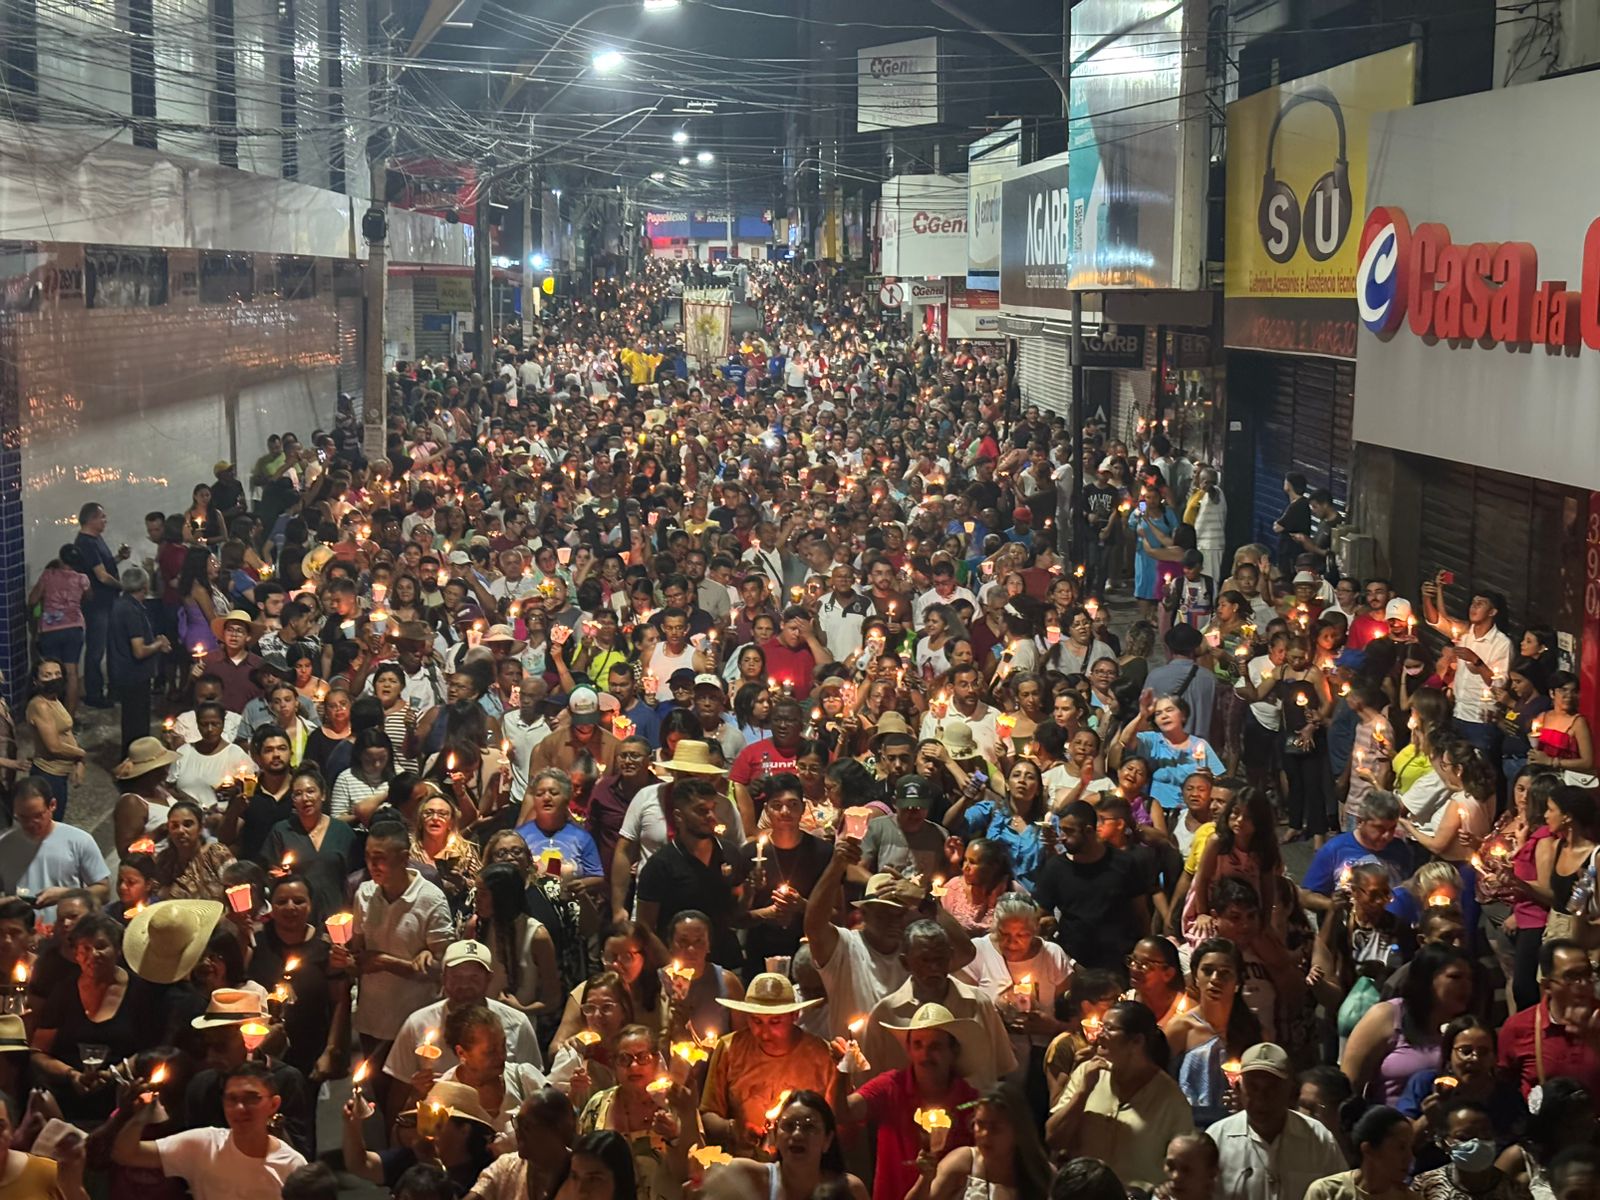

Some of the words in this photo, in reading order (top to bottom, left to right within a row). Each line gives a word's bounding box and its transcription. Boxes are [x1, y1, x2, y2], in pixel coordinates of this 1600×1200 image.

[1306, 268, 1336, 293] Assistência
[1408, 222, 1534, 341] Casa
[1530, 281, 1574, 346] da
